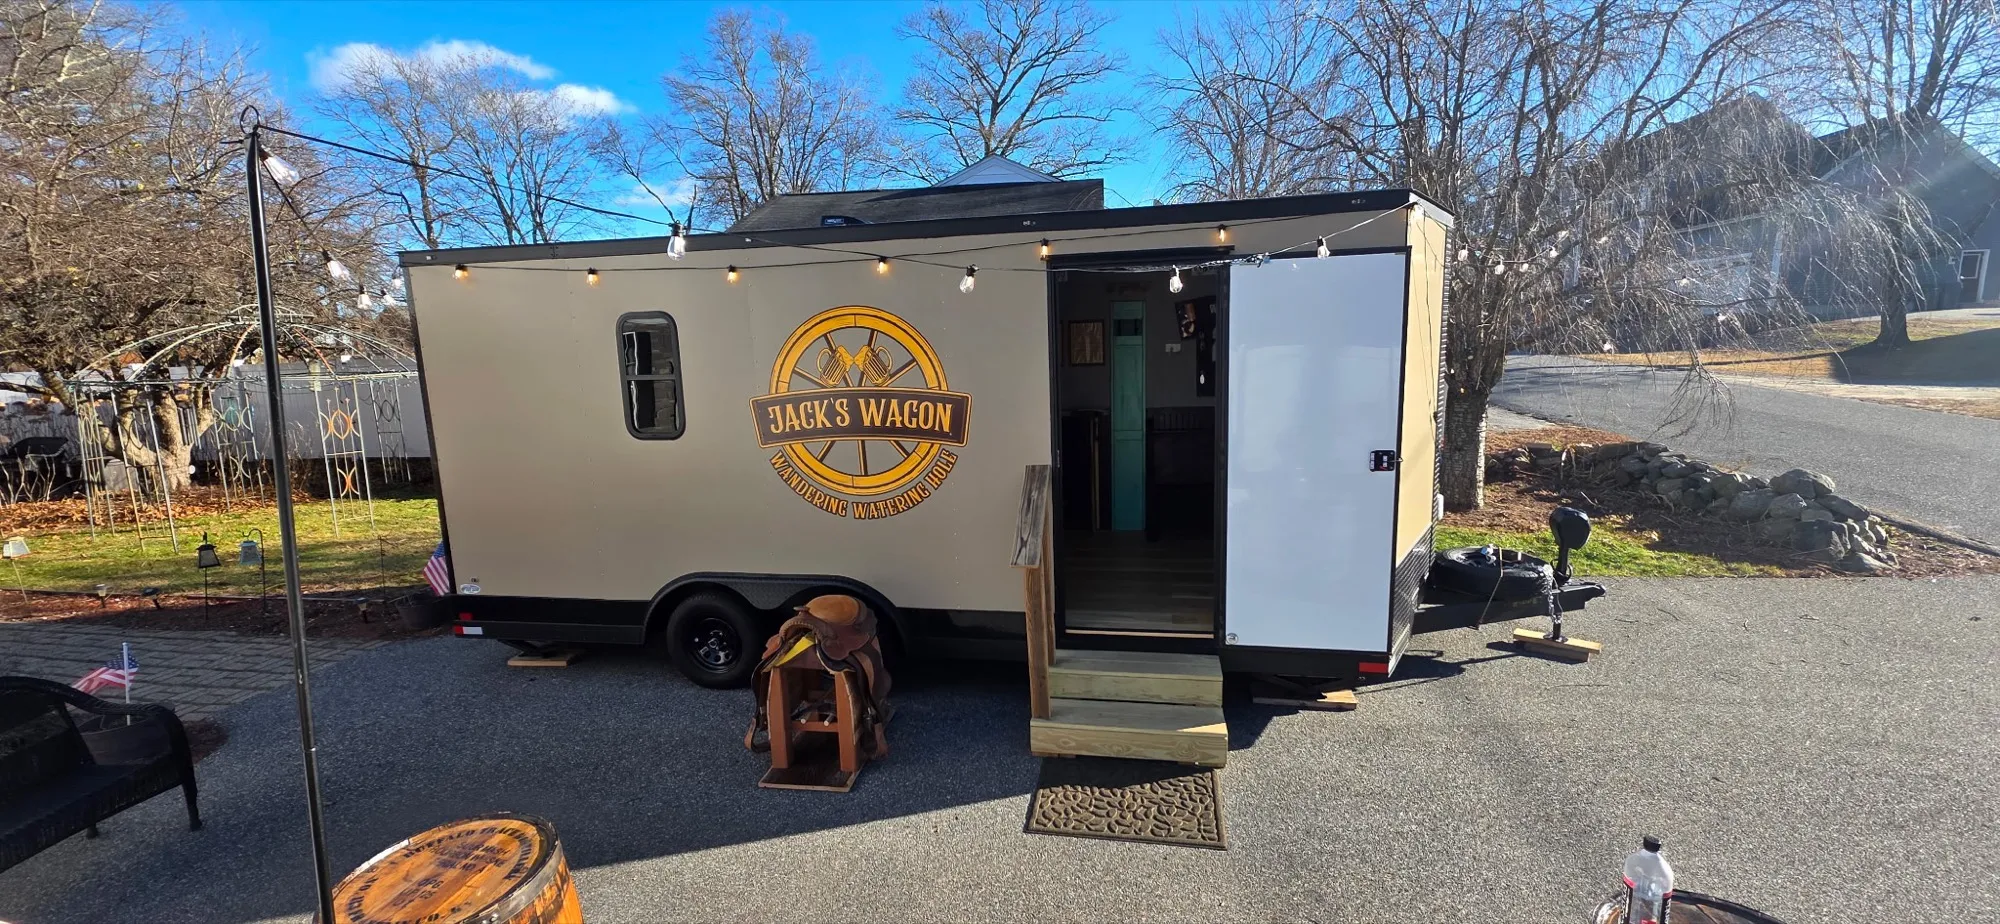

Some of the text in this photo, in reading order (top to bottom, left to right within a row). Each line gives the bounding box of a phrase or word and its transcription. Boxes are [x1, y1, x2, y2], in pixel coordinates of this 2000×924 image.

[767, 398, 953, 434] JACK'S WAGON
[769, 449, 959, 520] WANDERING WATERING HOLE
